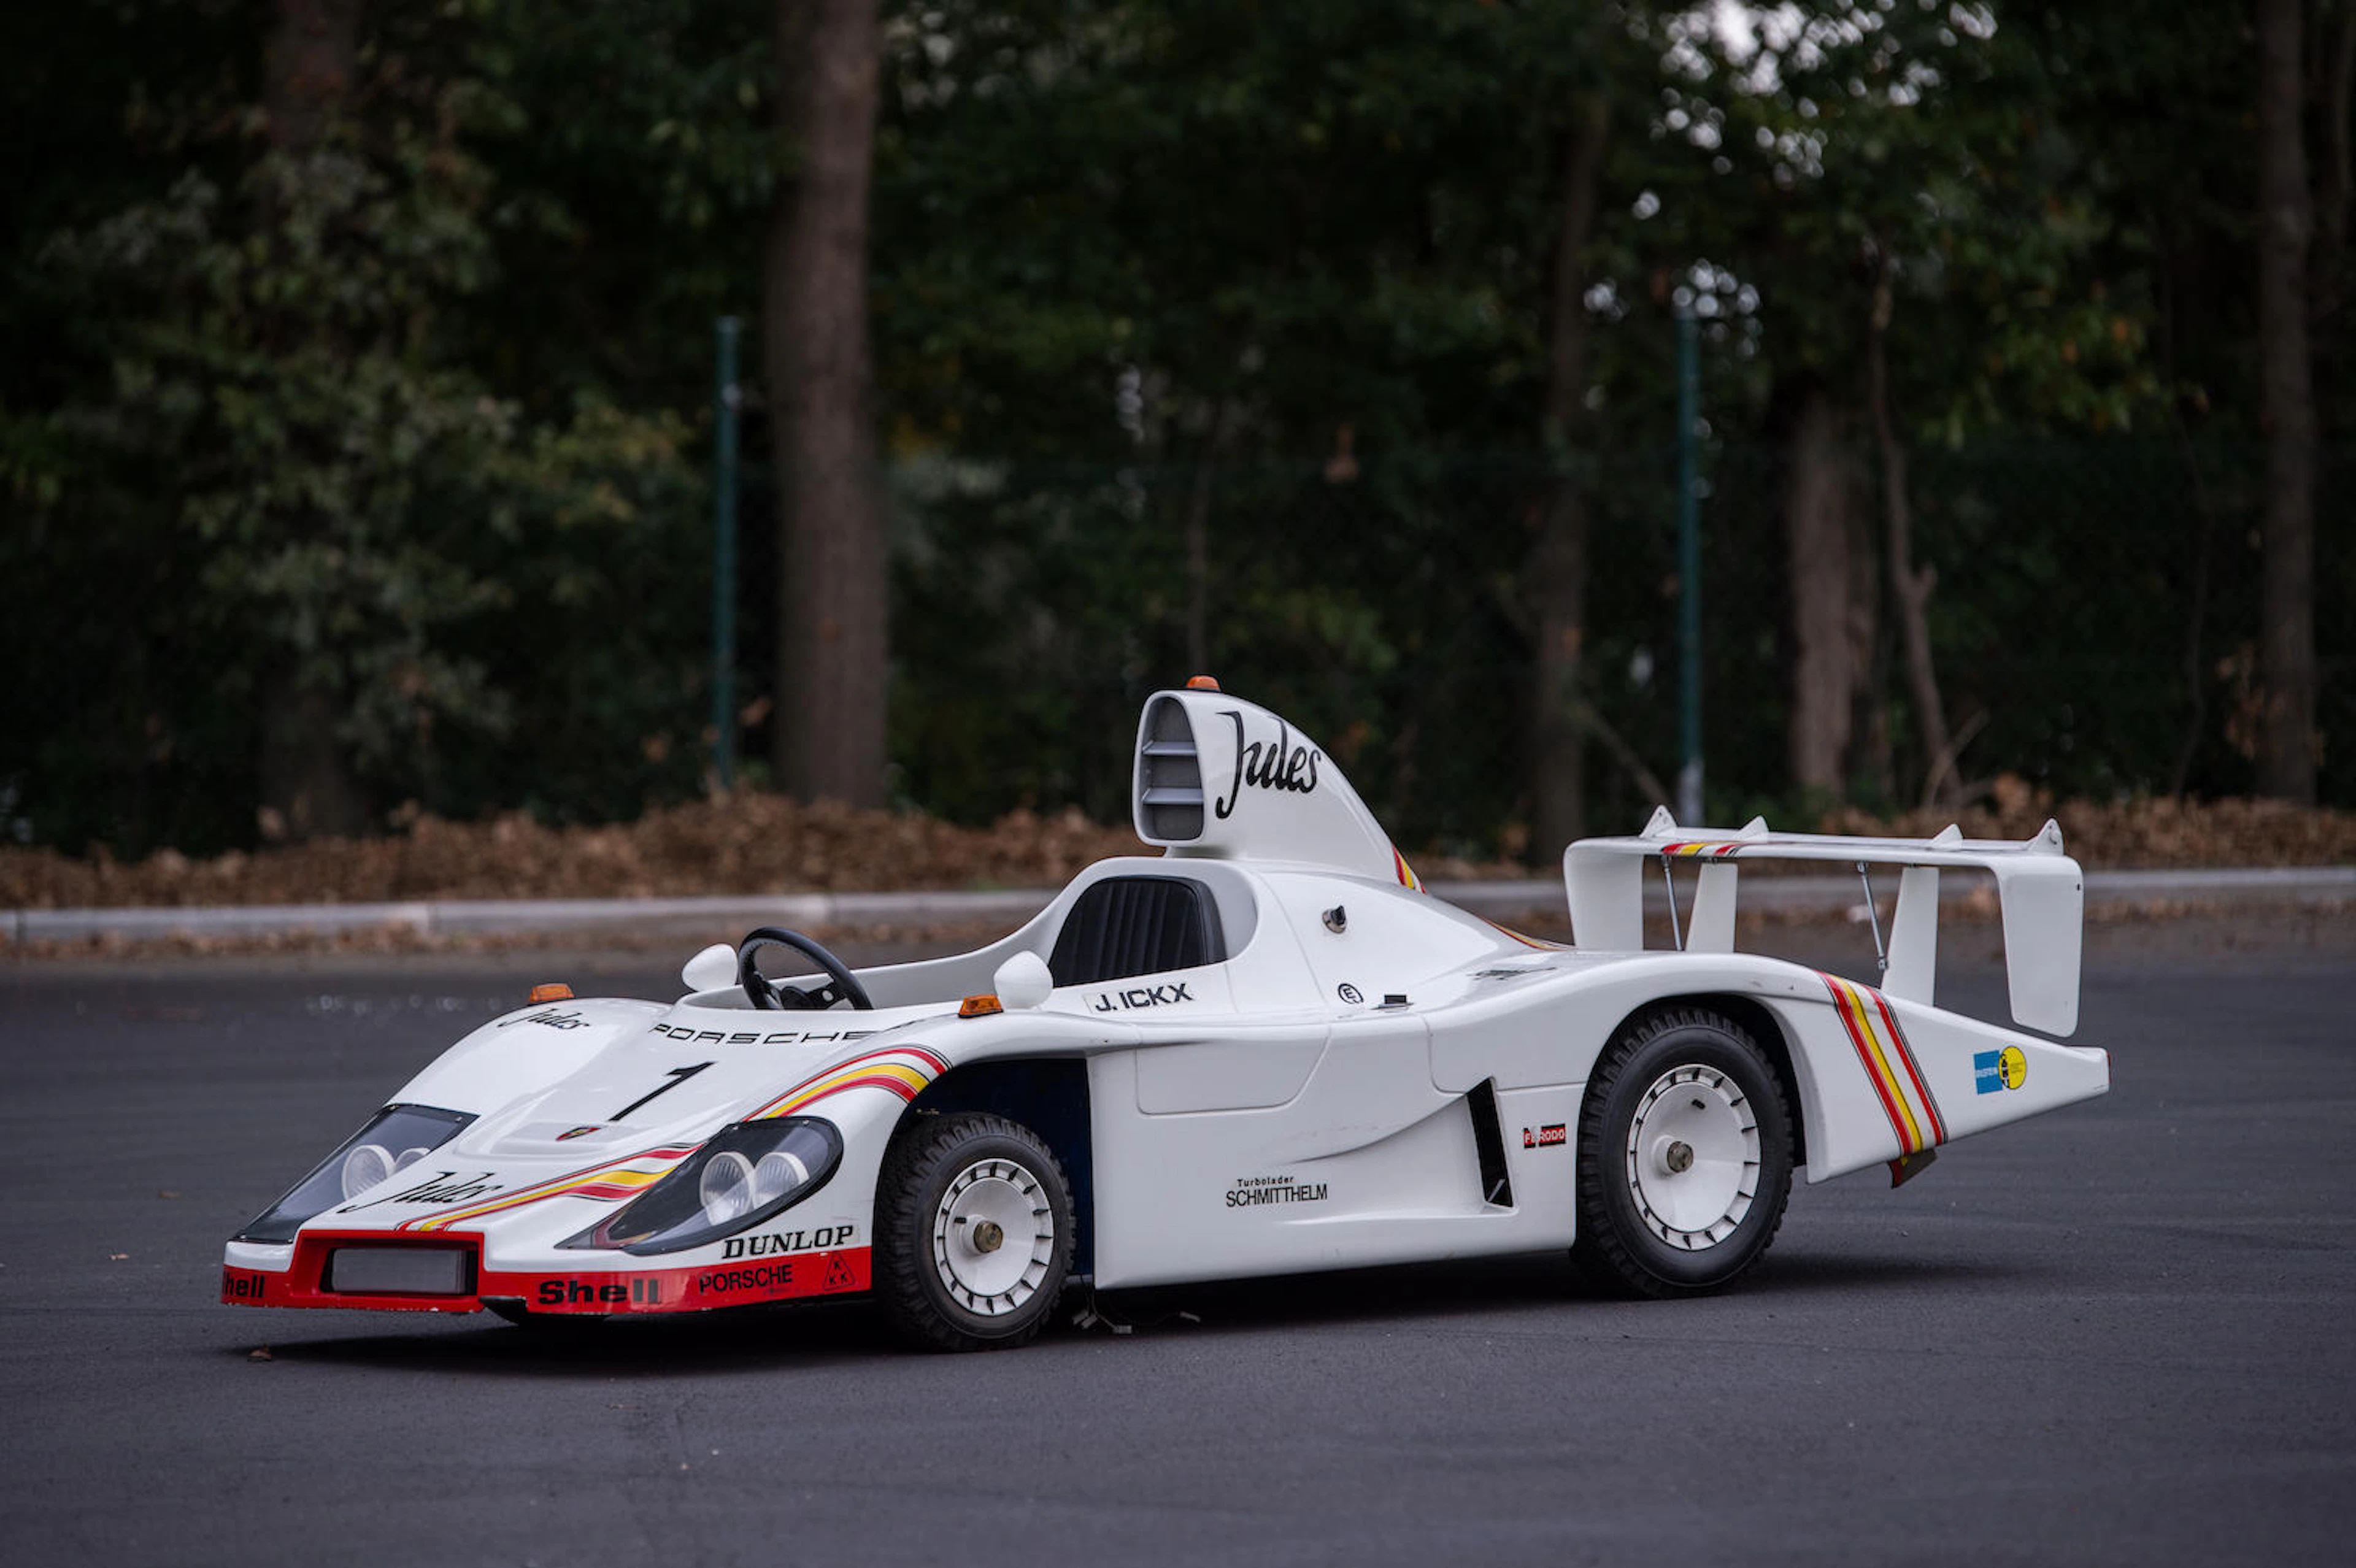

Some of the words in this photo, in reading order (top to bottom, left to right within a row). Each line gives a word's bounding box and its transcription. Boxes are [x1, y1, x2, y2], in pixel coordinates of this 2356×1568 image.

[1215, 711, 1321, 819] Jules
[498, 1008, 590, 1029] Jules
[649, 1023, 880, 1044] PORSCHE
[607, 1061, 718, 1122] 1
[336, 1171, 504, 1213] Jules
[1237, 1175, 1295, 1187] Turbolader
[1226, 1183, 1327, 1207] SCHMITTHELM
[722, 1225, 853, 1259] DUNLOP
[223, 1271, 265, 1297] hell
[538, 1278, 658, 1304] Shell
[699, 1264, 793, 1293] PORSCHE
